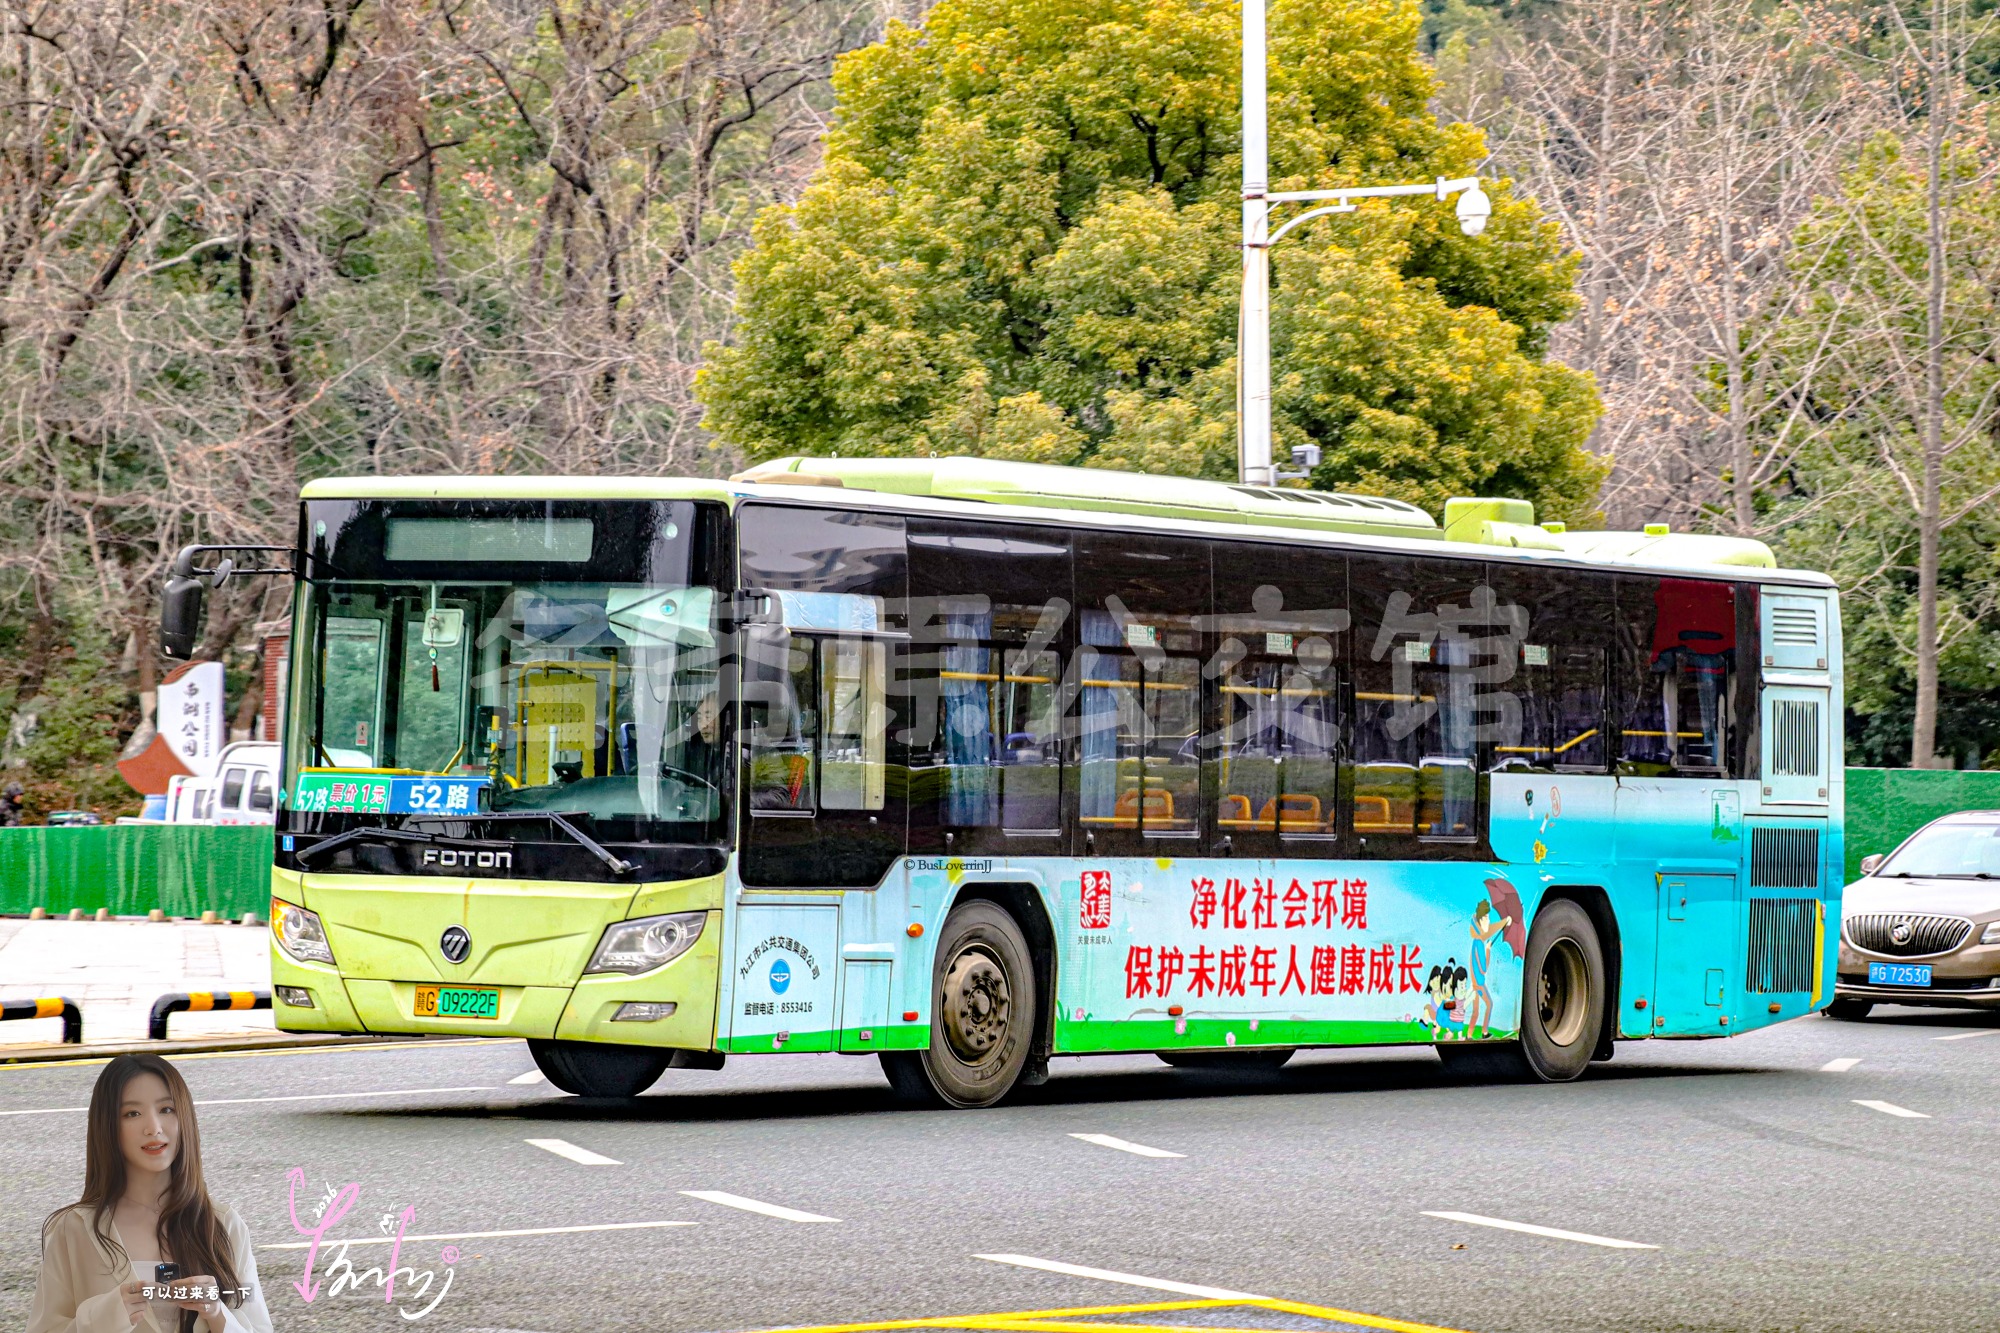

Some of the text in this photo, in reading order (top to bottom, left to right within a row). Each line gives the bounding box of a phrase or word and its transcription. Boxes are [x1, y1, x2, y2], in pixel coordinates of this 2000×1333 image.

[409, 784, 469, 809] 52路
[423, 850, 513, 868] FOTON
[1190, 877, 1369, 930] 净化社会环境
[739, 935, 821, 981] 九江市公共交通集团公司
[1124, 943, 1424, 999] 保护未成年人健康成长
